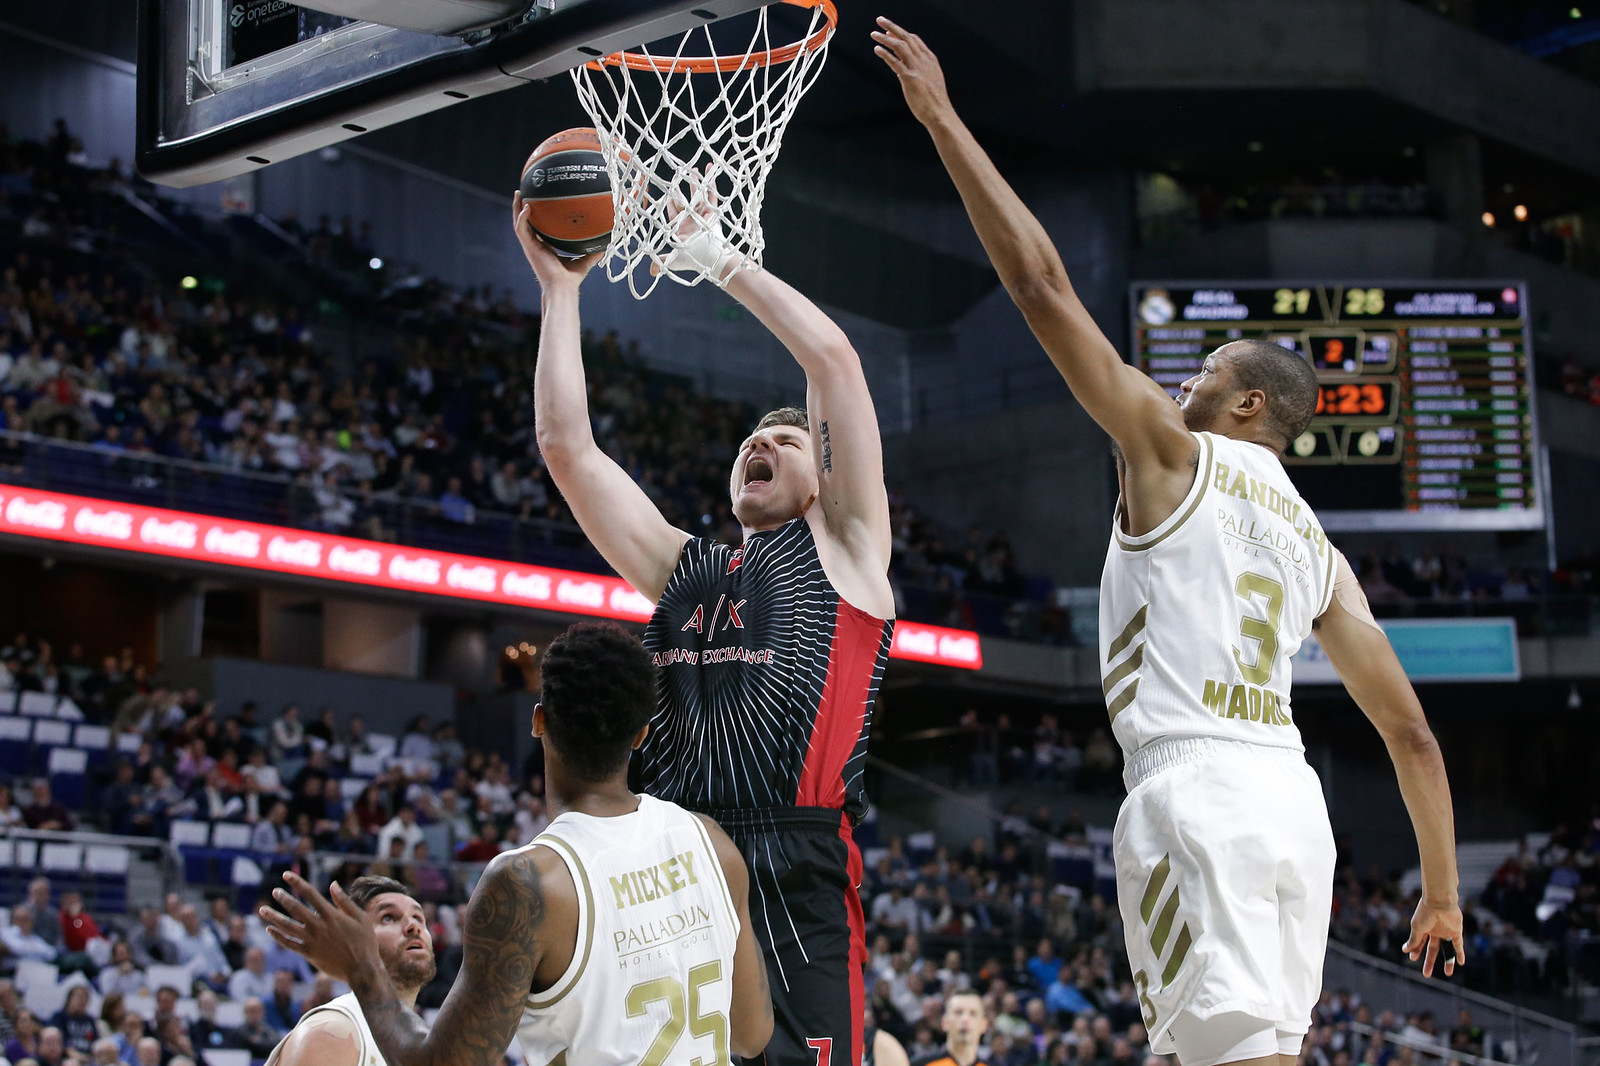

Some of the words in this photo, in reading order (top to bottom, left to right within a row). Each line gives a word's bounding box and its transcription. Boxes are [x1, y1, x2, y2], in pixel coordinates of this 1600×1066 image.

[1316, 384, 1384, 414] :23
[651, 647, 699, 667] ARANI
[702, 645, 776, 665] EXCHANGE
[1232, 571, 1283, 686] 3
[609, 851, 698, 910] MICKEY
[625, 959, 729, 1066] 25
